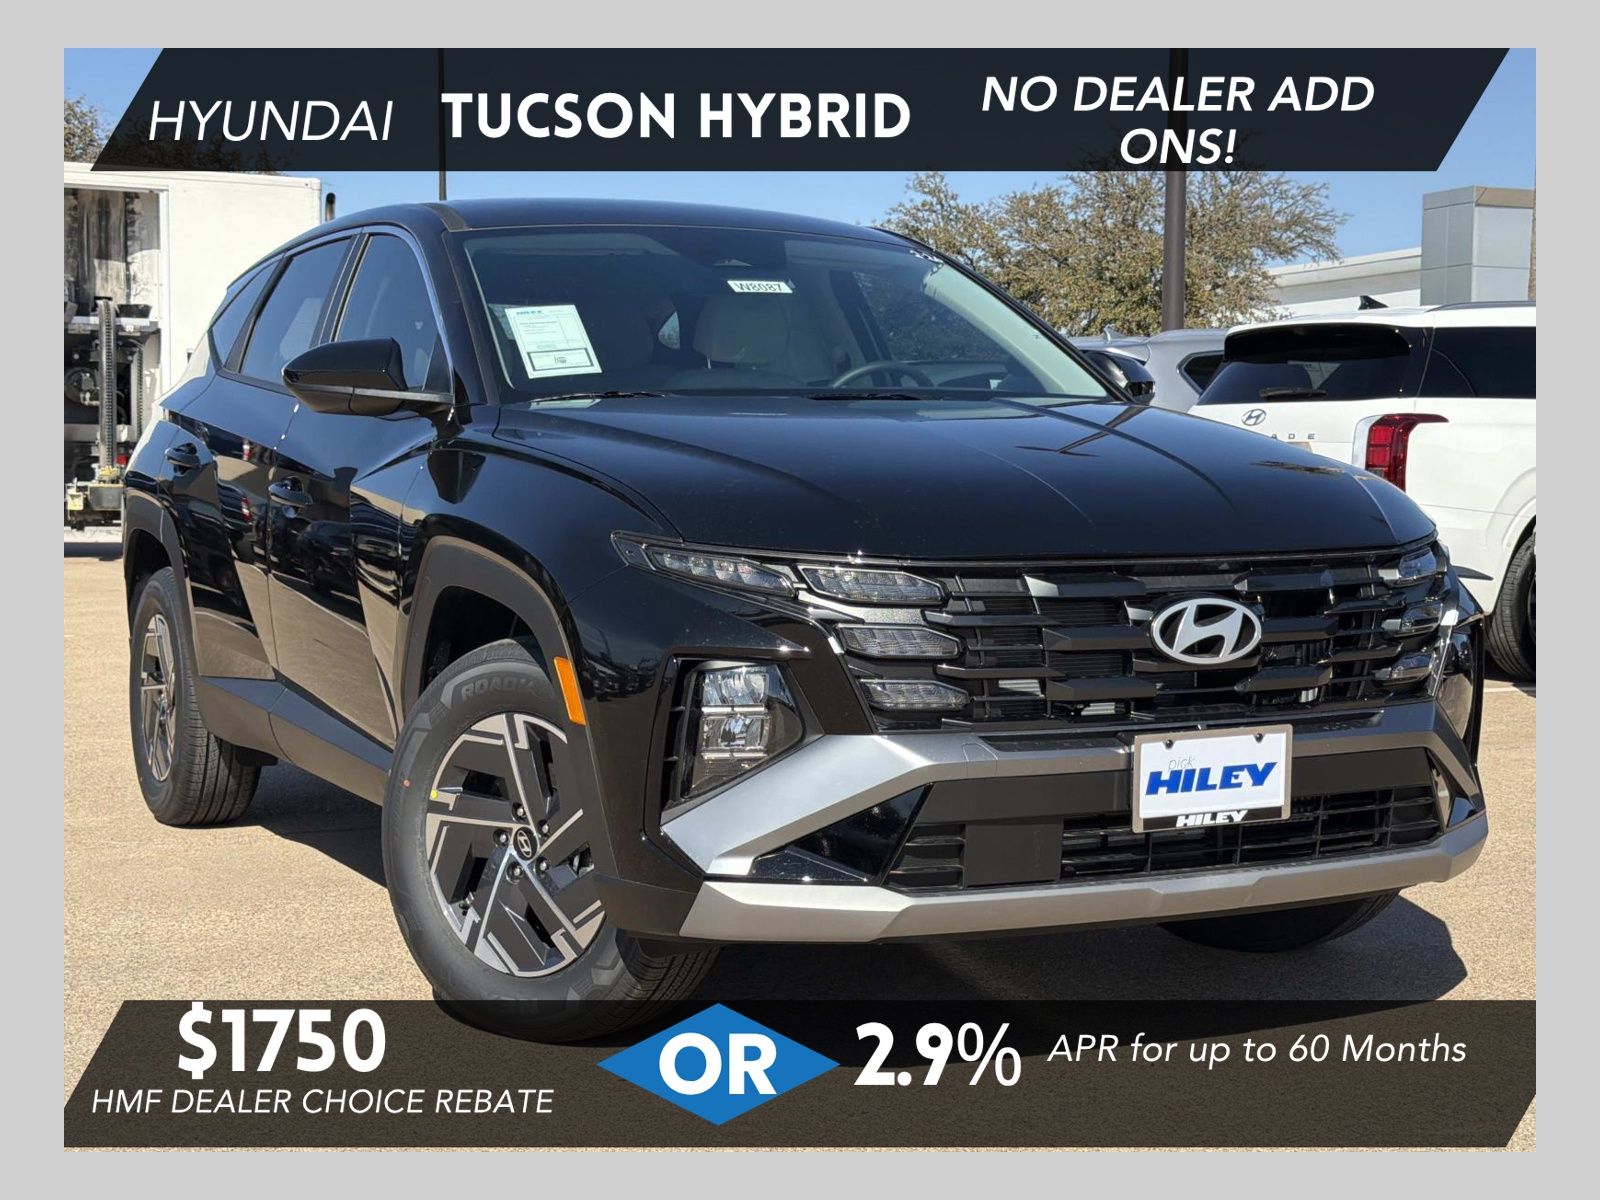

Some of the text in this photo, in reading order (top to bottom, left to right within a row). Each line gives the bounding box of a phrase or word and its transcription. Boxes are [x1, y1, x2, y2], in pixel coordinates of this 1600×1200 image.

[734, 282, 782, 291] W8087
[1168, 756, 1195, 771] pick
[1146, 762, 1277, 795] HILEY
[1176, 809, 1249, 828] HILEY
